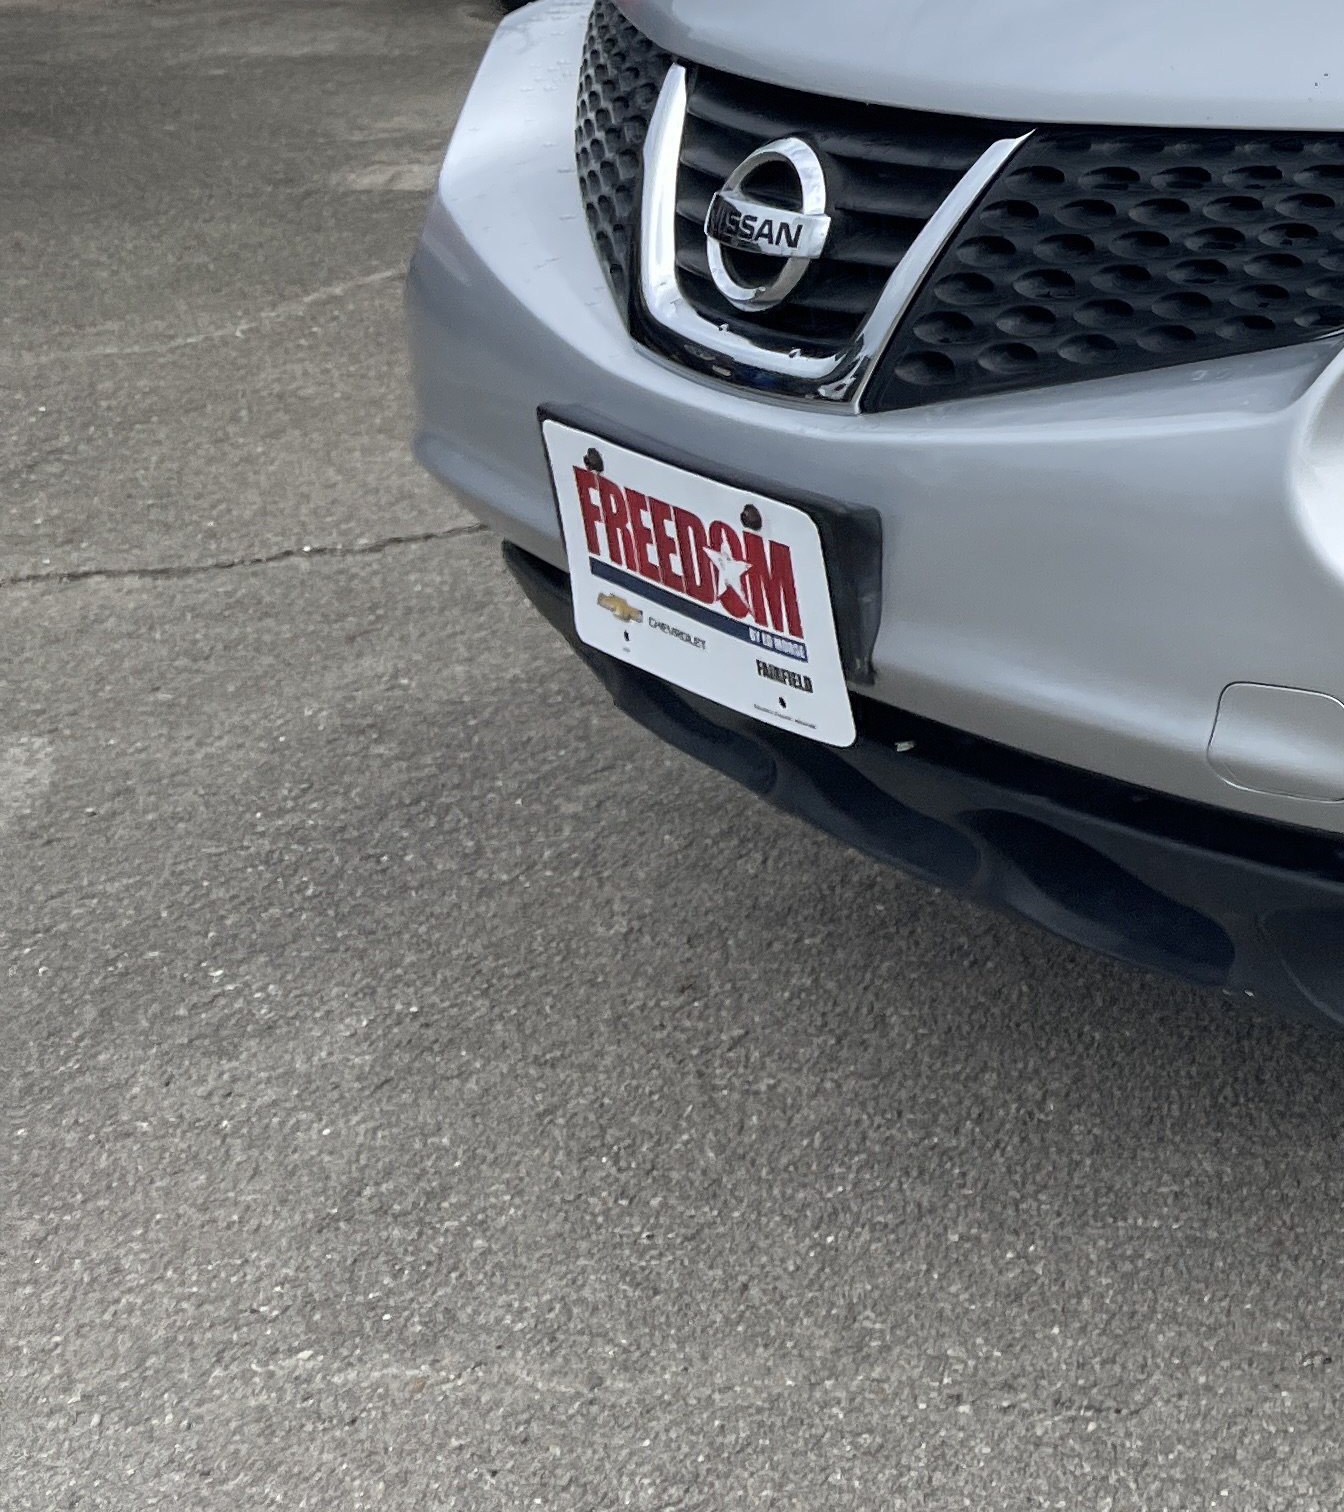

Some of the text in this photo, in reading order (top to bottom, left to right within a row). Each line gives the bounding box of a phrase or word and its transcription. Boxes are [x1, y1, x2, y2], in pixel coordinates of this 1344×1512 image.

[707, 204, 803, 249] NISSAN
[572, 465, 803, 639] FREEDOM
[648, 616, 707, 650] CHEVROLET
[755, 659, 814, 693] FAIRFIELD
